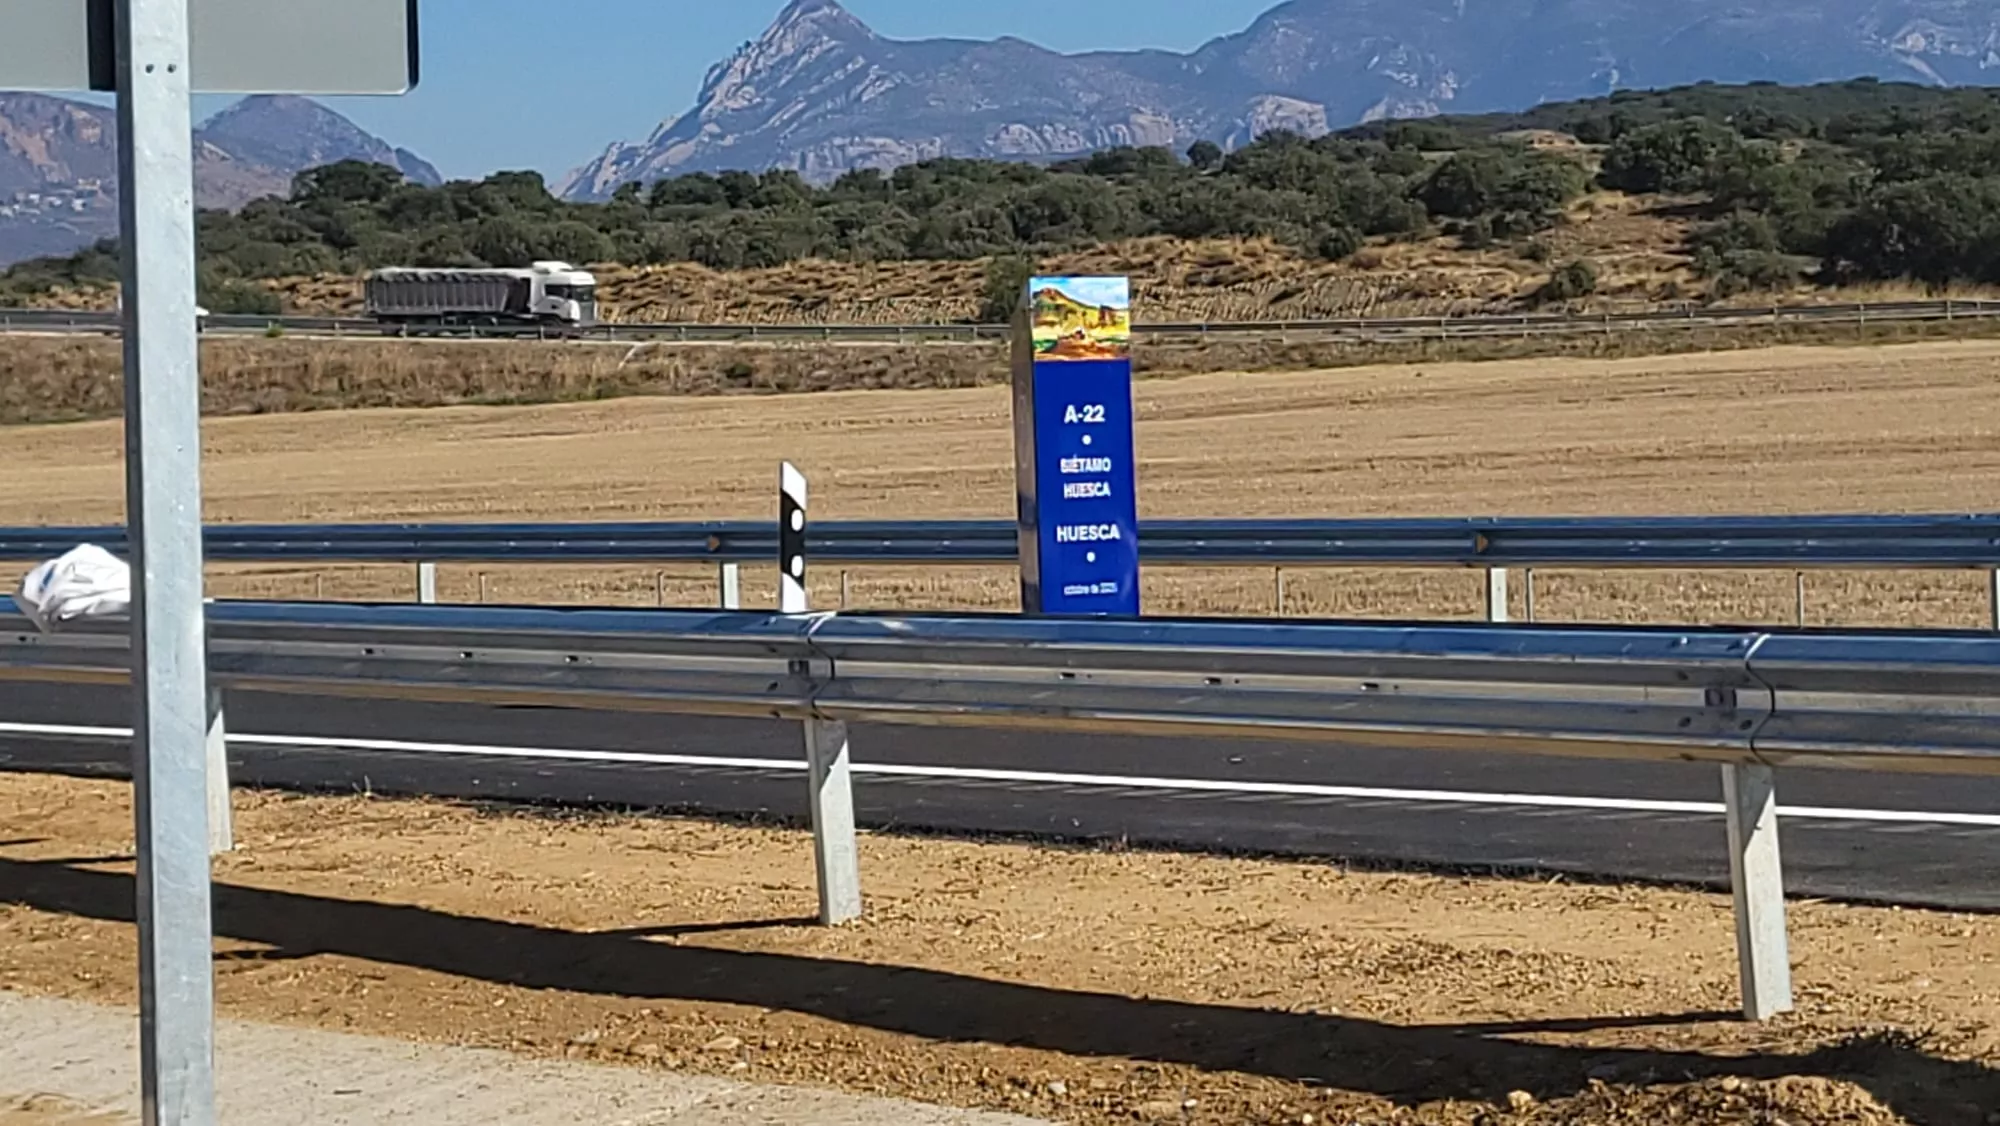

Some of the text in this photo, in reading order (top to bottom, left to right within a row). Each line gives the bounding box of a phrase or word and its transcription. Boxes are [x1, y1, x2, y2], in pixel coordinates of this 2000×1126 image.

[1064, 404, 1106, 423] A-22
[1063, 481, 1111, 499] HUESCA
[1056, 523, 1121, 542] HUESCA
